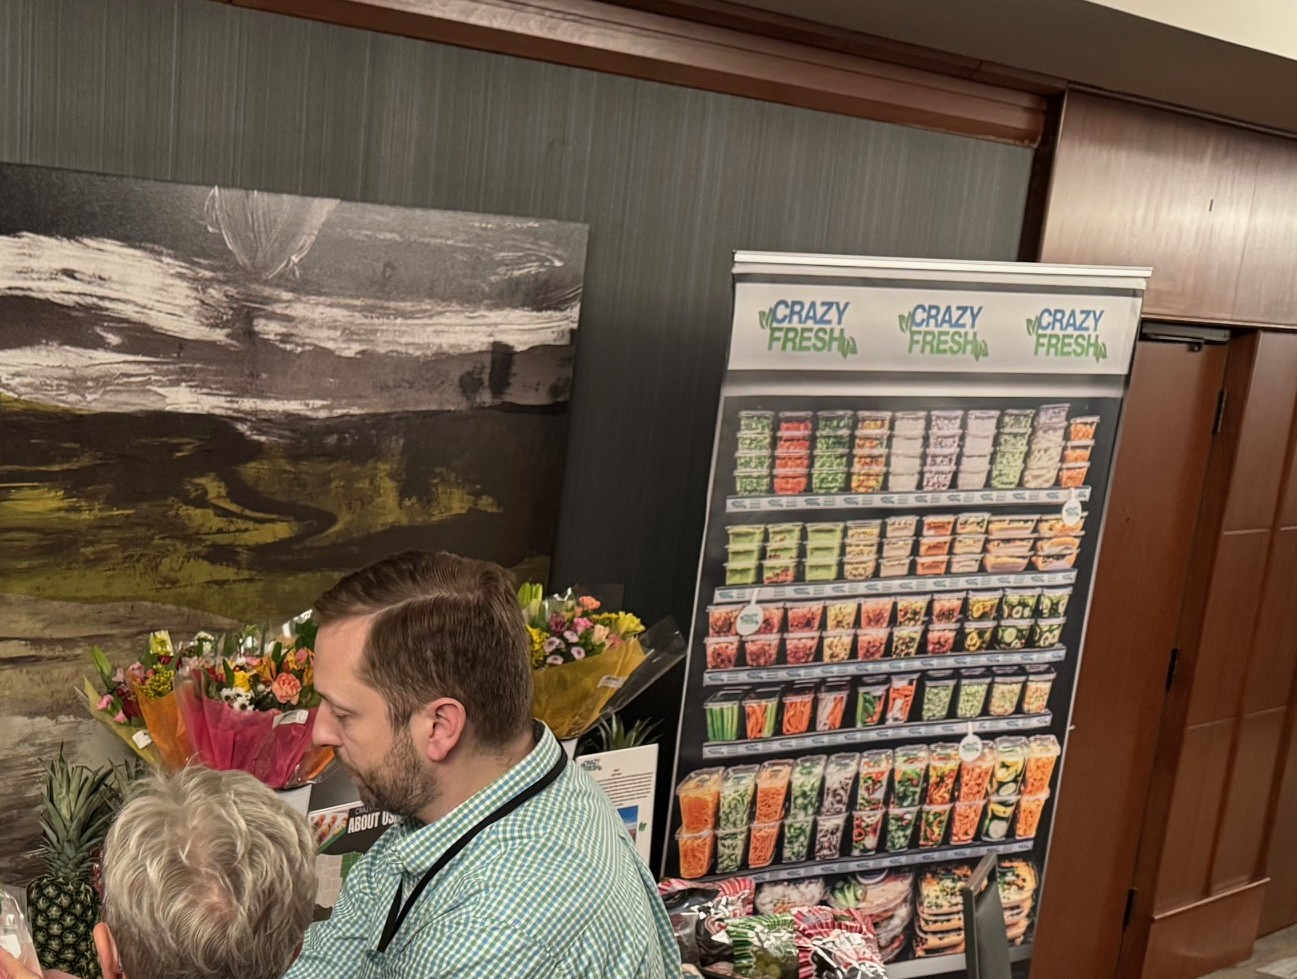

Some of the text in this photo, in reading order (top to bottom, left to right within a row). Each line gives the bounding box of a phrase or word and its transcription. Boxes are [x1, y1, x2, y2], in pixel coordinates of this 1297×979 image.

[772, 299, 850, 325] CRAZY
[911, 304, 984, 329] CRAZY
[1037, 308, 1105, 331] CRAZY
[767, 327, 846, 352] FRESH
[907, 330, 979, 355] FRESH
[1034, 334, 1100, 357] FRESH
[347, 812, 380, 834] ABOUT
